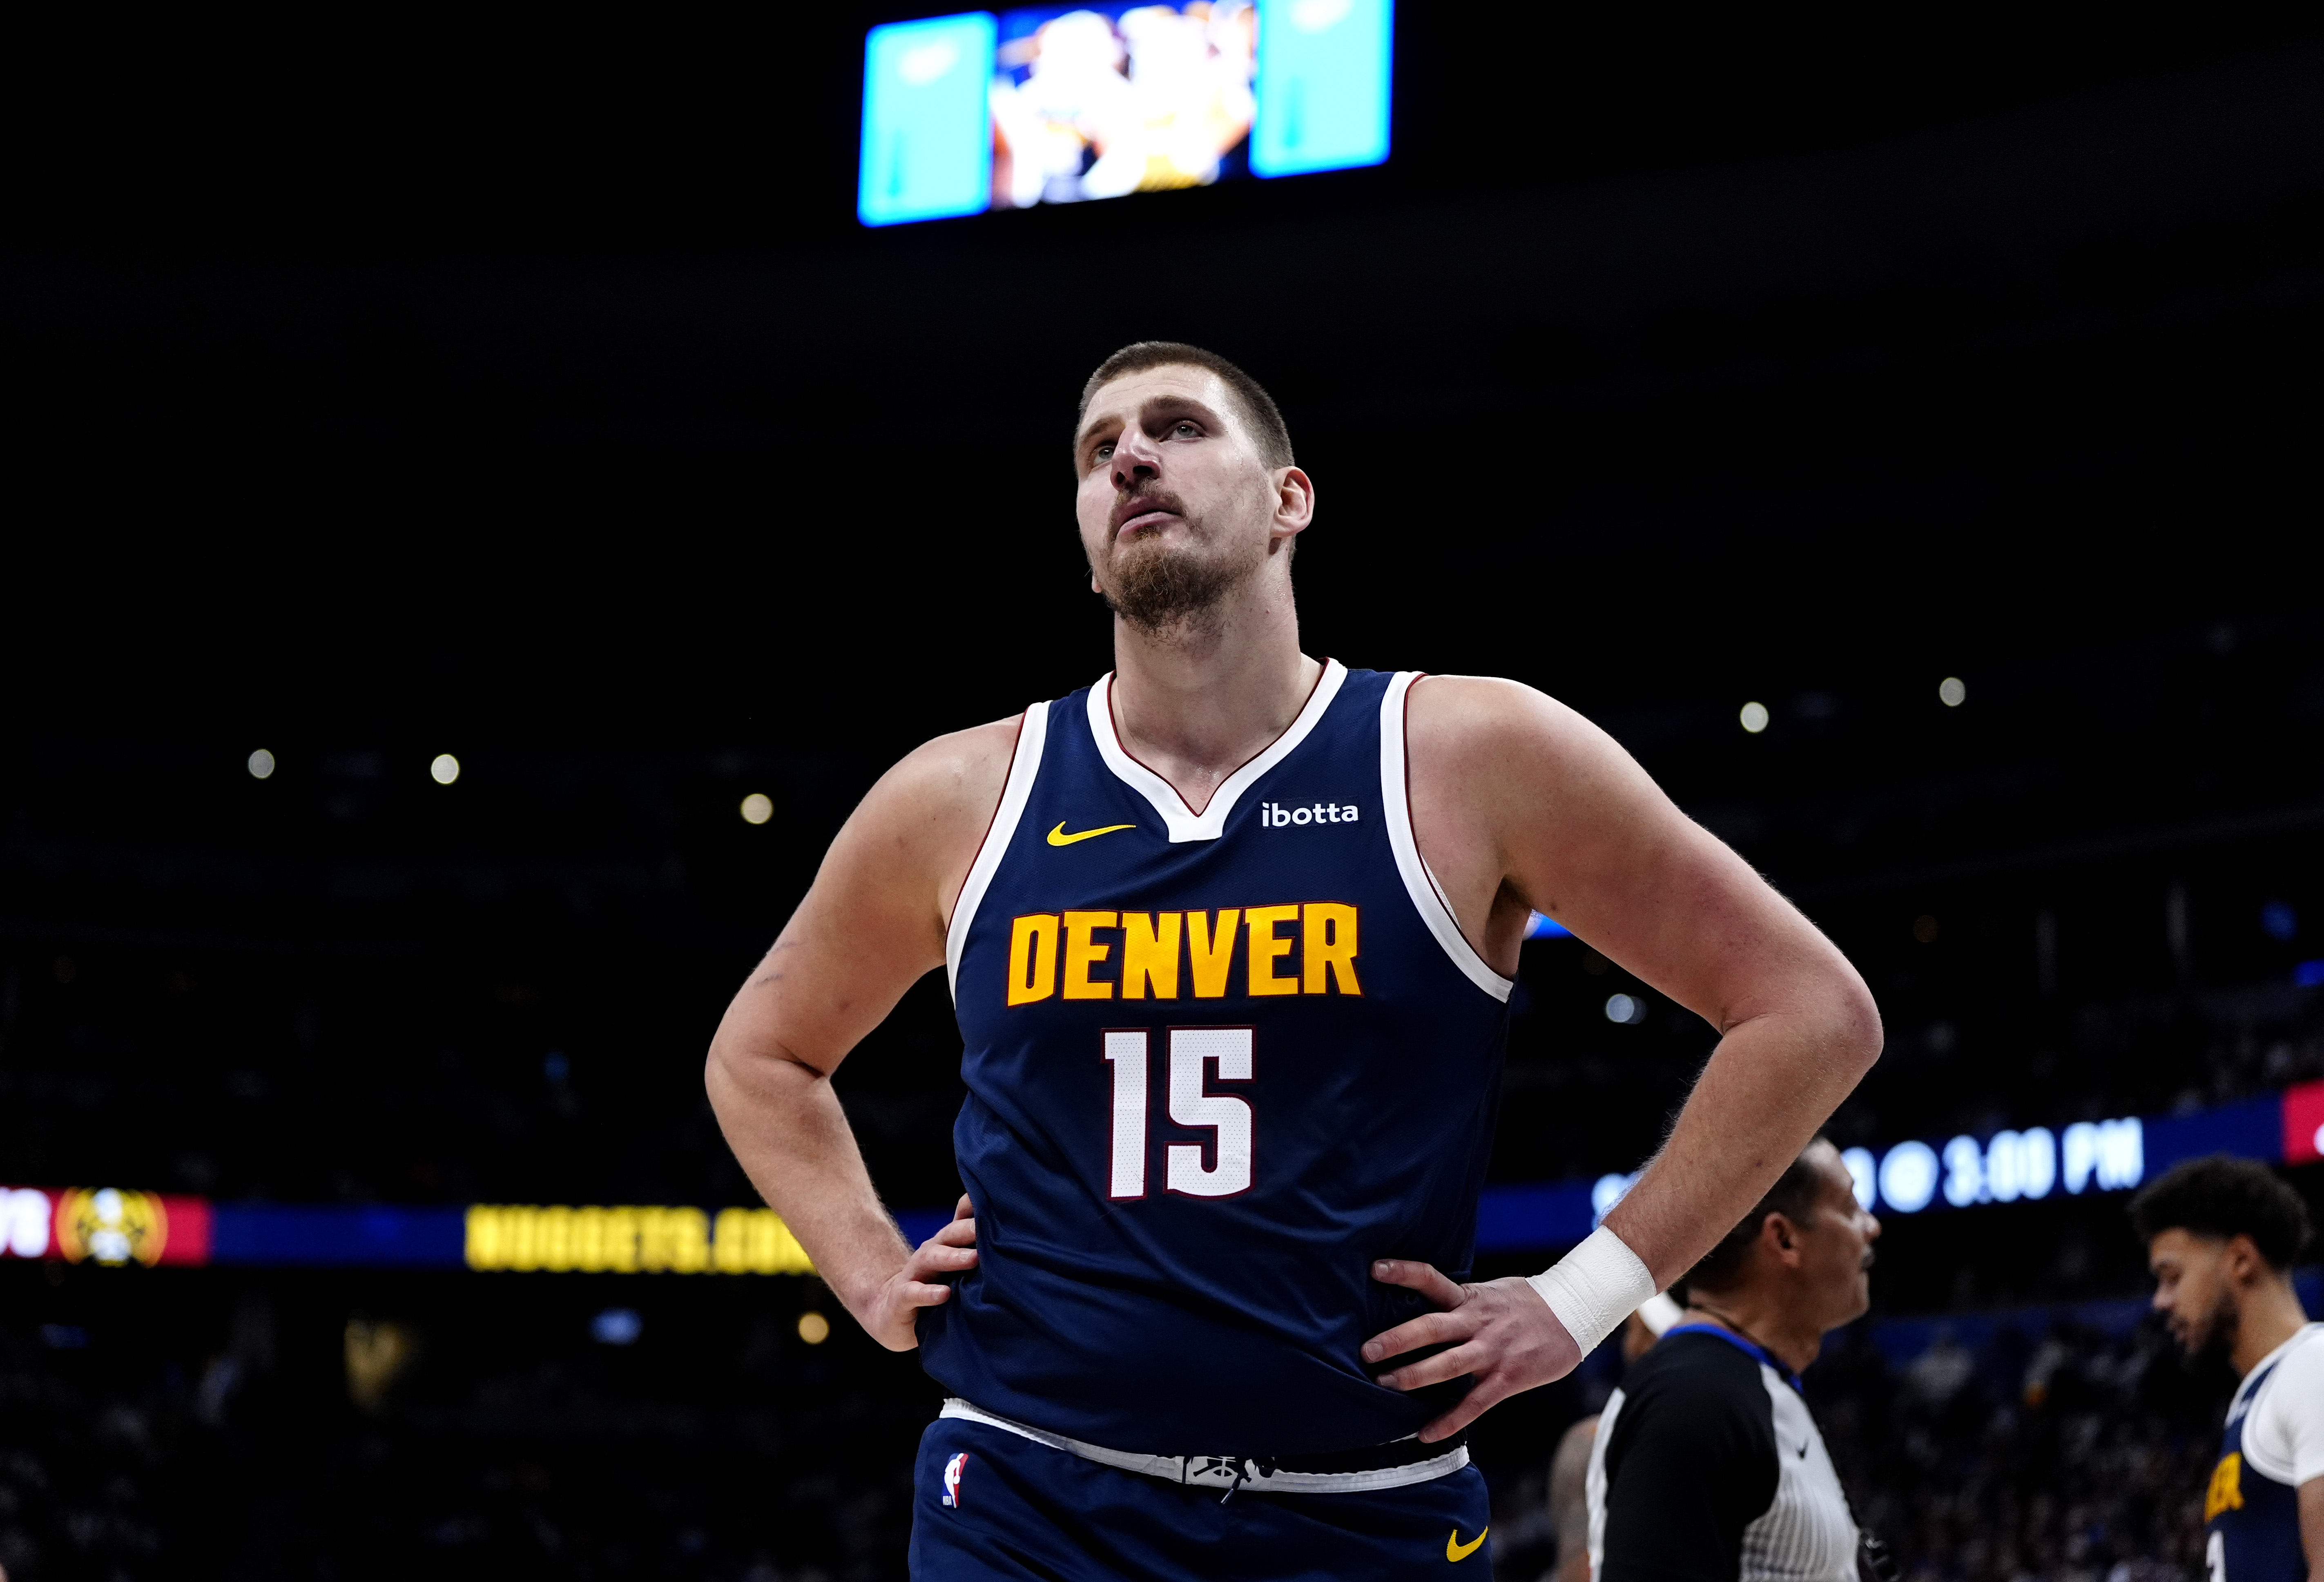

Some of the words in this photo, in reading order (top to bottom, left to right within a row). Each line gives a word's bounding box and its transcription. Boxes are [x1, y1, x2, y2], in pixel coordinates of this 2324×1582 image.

[1262, 802, 1358, 827] ibotta
[1007, 901, 1365, 1008] DENVER
[1101, 1025, 1256, 1200] 15
[2063, 1117, 2143, 1193] PM
[943, 1495, 952, 1506] NBA
